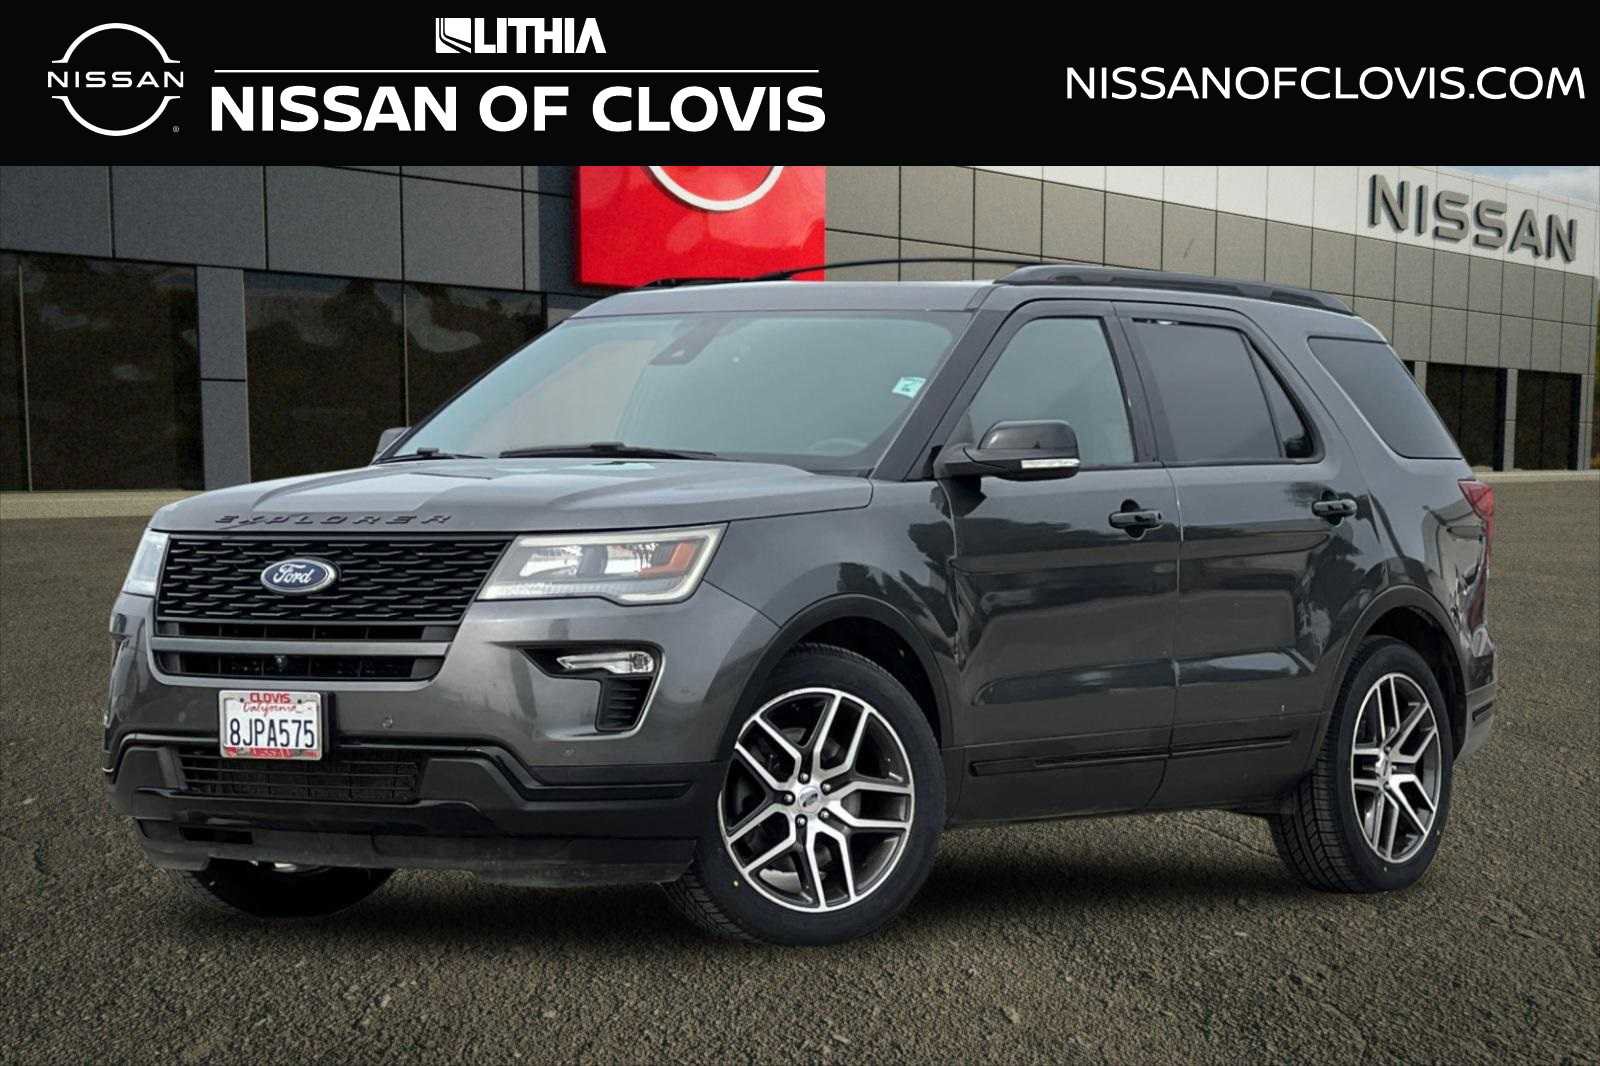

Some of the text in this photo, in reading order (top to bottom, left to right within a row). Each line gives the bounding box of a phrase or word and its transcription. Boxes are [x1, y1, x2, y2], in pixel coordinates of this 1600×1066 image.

[1368, 174, 1577, 262] NISSAN
[215, 514, 453, 525] EXPLORER
[272, 563, 314, 585] Ford
[249, 692, 291, 704] CLOVIS
[229, 718, 315, 748] 8JPA575
